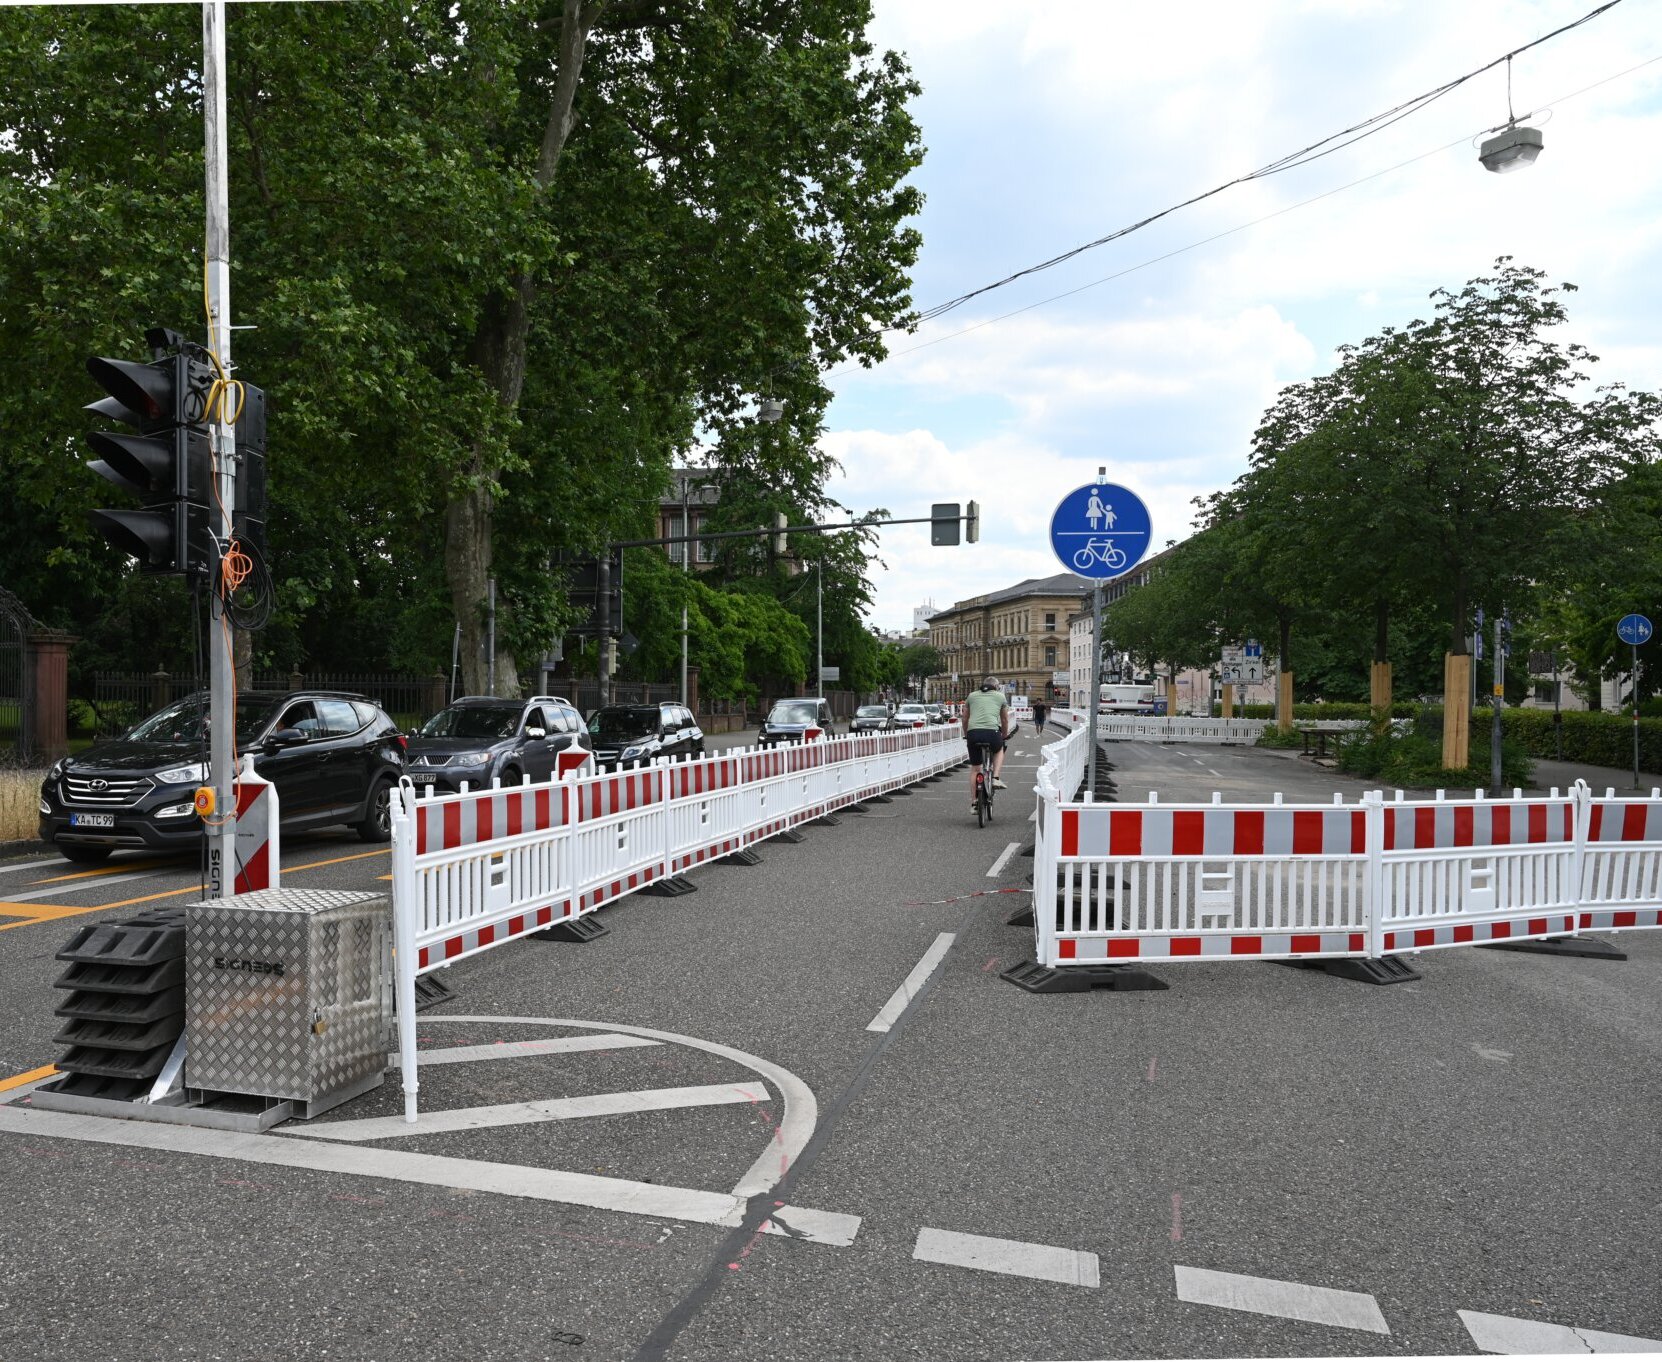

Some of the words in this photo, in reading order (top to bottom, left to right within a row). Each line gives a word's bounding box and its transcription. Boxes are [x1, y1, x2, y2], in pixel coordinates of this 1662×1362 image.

[75, 815, 86, 825] KA
[91, 815, 102, 825] TC
[102, 815, 113, 826] 99
